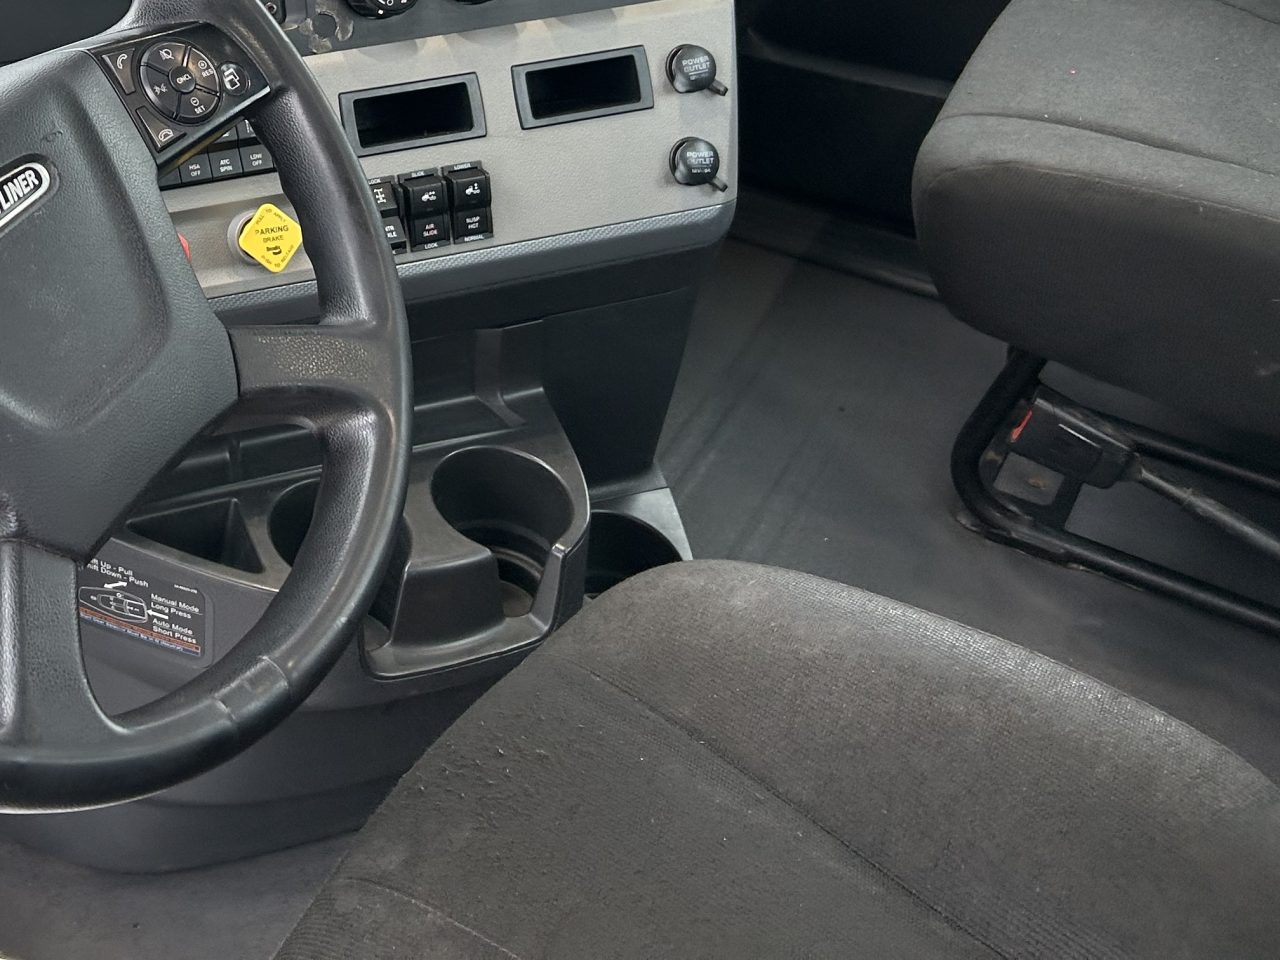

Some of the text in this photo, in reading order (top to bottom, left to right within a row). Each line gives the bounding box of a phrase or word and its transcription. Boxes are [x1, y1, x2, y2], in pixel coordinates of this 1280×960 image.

[682, 55, 709, 66] POWER
[684, 61, 711, 73] OUTLET
[201, 69, 214, 78] RES
[194, 105, 206, 114] SET
[453, 162, 471, 170] LOWER
[687, 157, 715, 165] OUTLET
[189, 163, 201, 171] HSA
[255, 225, 289, 235] PARKING
[423, 229, 438, 237] SLIDE
[263, 235, 284, 243] BRAKE
[464, 234, 484, 242] NORMAL
[100, 561, 111, 569] Up
[118, 566, 133, 576] Pull
[100, 566, 122, 579] Down
[129, 576, 149, 588] Push
[150, 593, 177, 607] Manual
[178, 601, 200, 613] Mode
[150, 602, 169, 614] Long
[170, 608, 192, 619] Press
[153, 618, 193, 635] Auto Mode
[153, 626, 197, 643] Short Press
